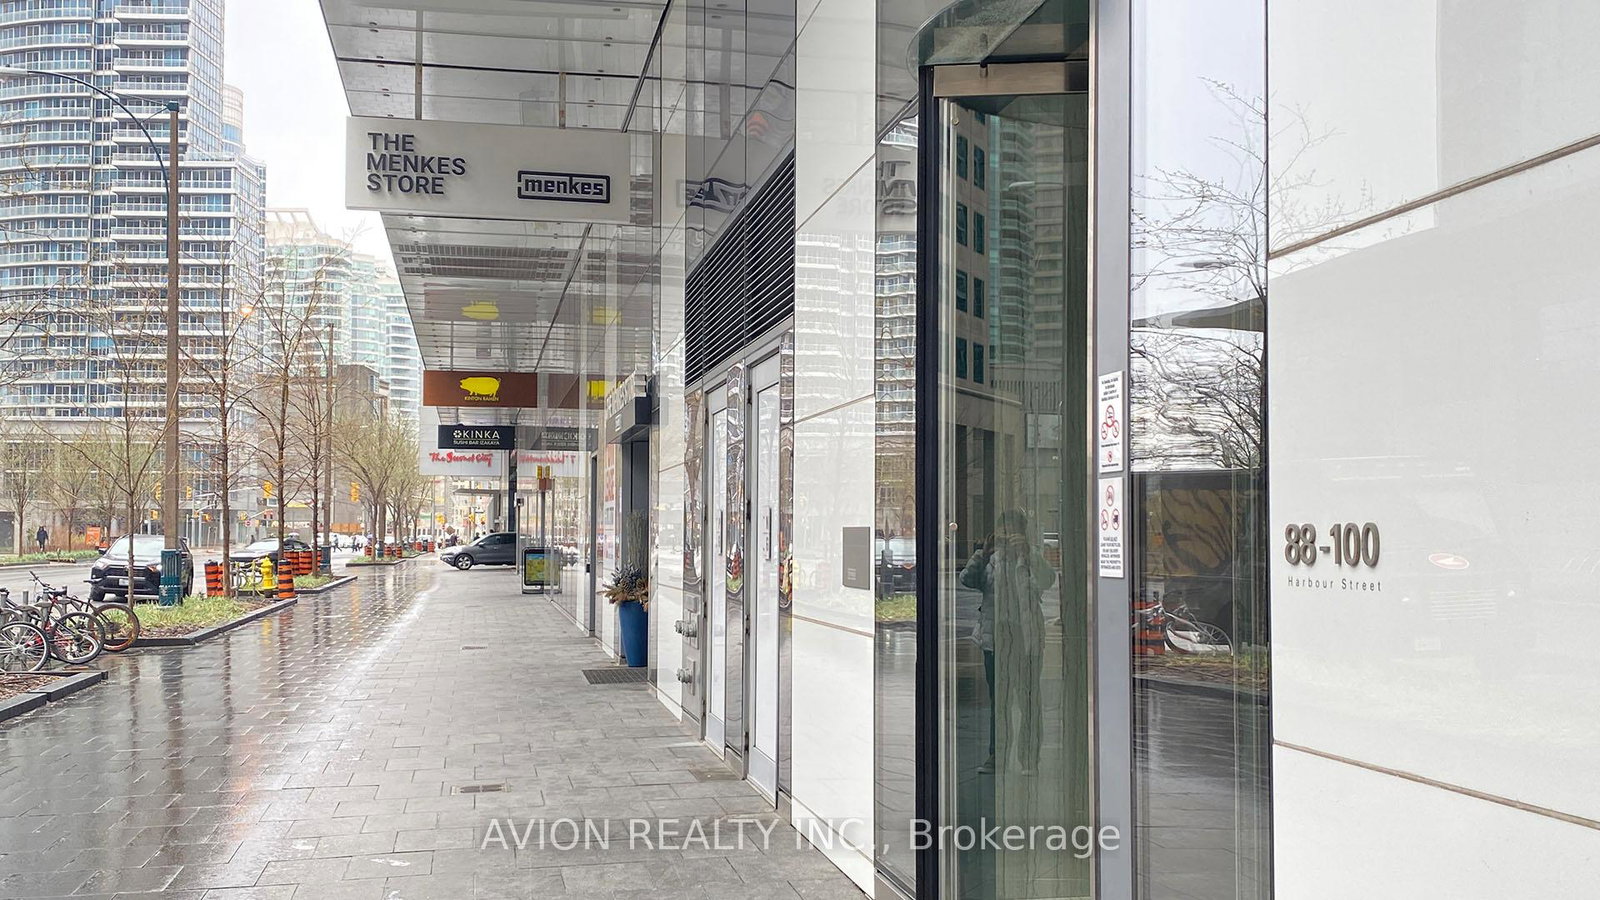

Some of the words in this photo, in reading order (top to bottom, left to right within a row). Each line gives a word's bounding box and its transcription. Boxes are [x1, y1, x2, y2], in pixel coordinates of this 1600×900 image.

[367, 132, 415, 152] THE
[366, 152, 466, 176] MENKES
[366, 173, 444, 195] STORE
[524, 177, 604, 196] menkes
[463, 430, 500, 439] KINKA
[1285, 522, 1380, 568] 88-100
[1287, 576, 1334, 589] Harbour
[1341, 578, 1382, 592] Street
